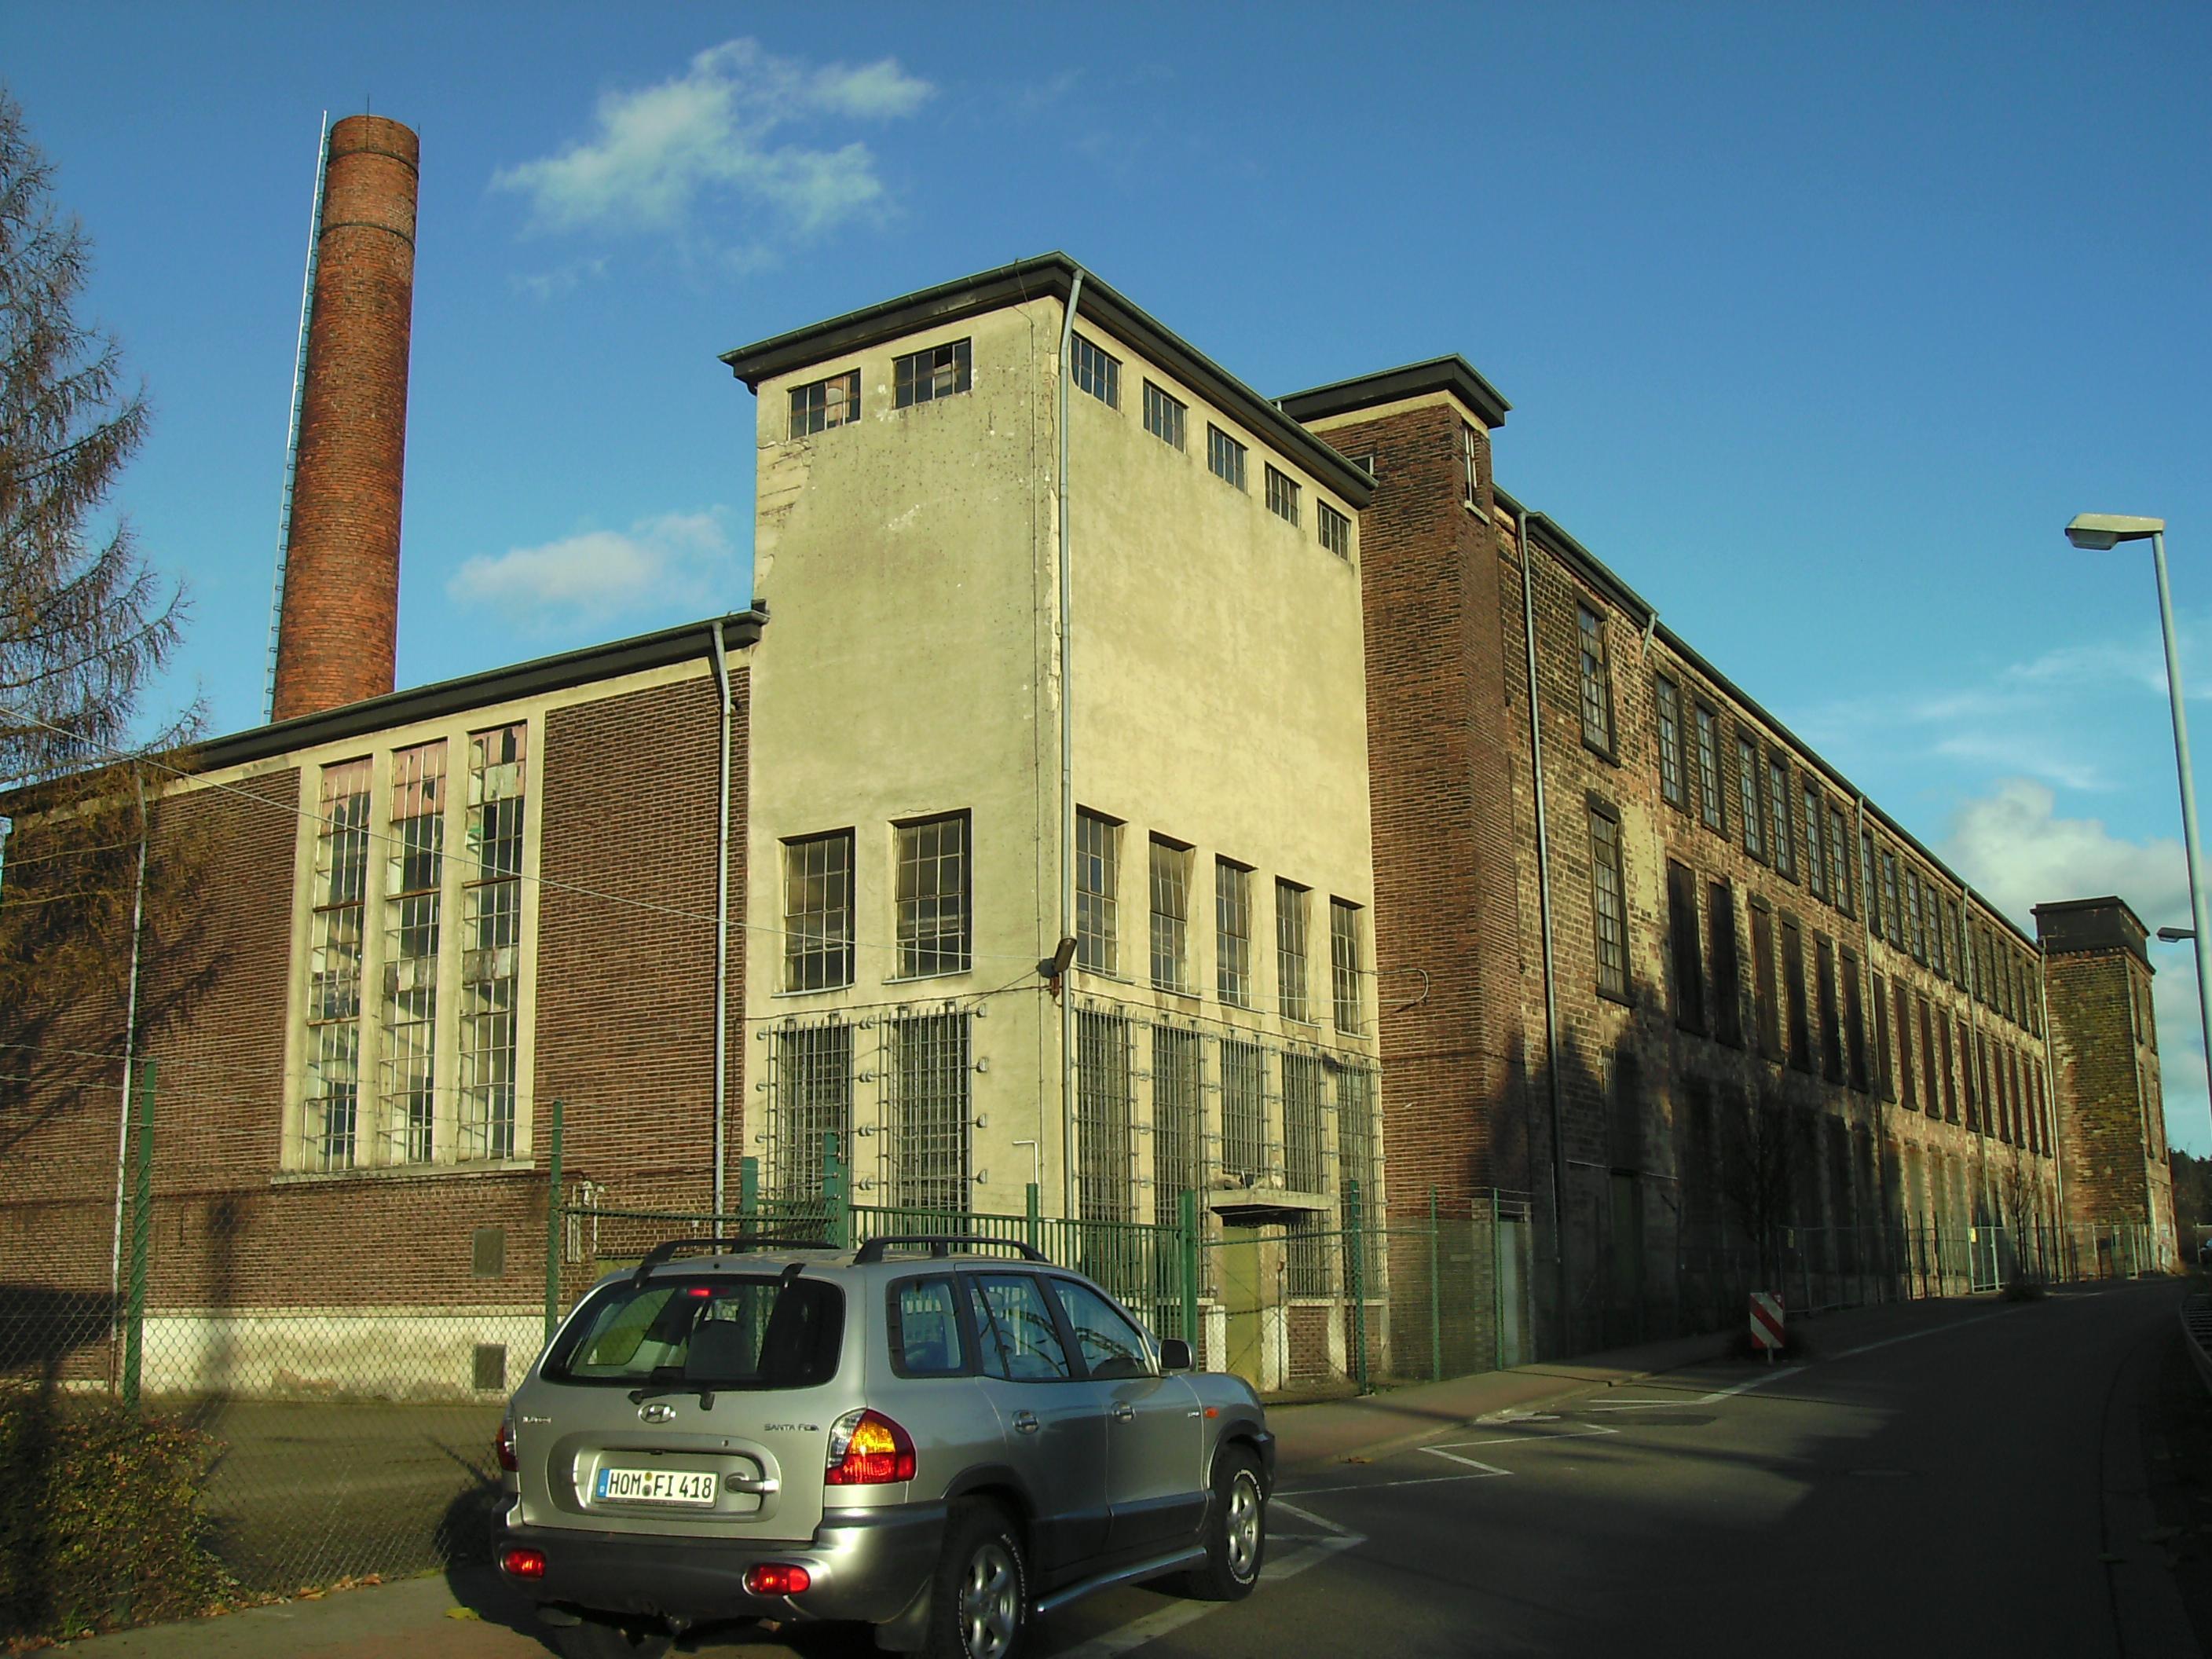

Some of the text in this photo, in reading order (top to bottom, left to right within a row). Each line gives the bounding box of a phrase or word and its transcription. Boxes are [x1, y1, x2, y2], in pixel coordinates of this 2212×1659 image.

[609, 1472, 712, 1499] HOM FI 418
